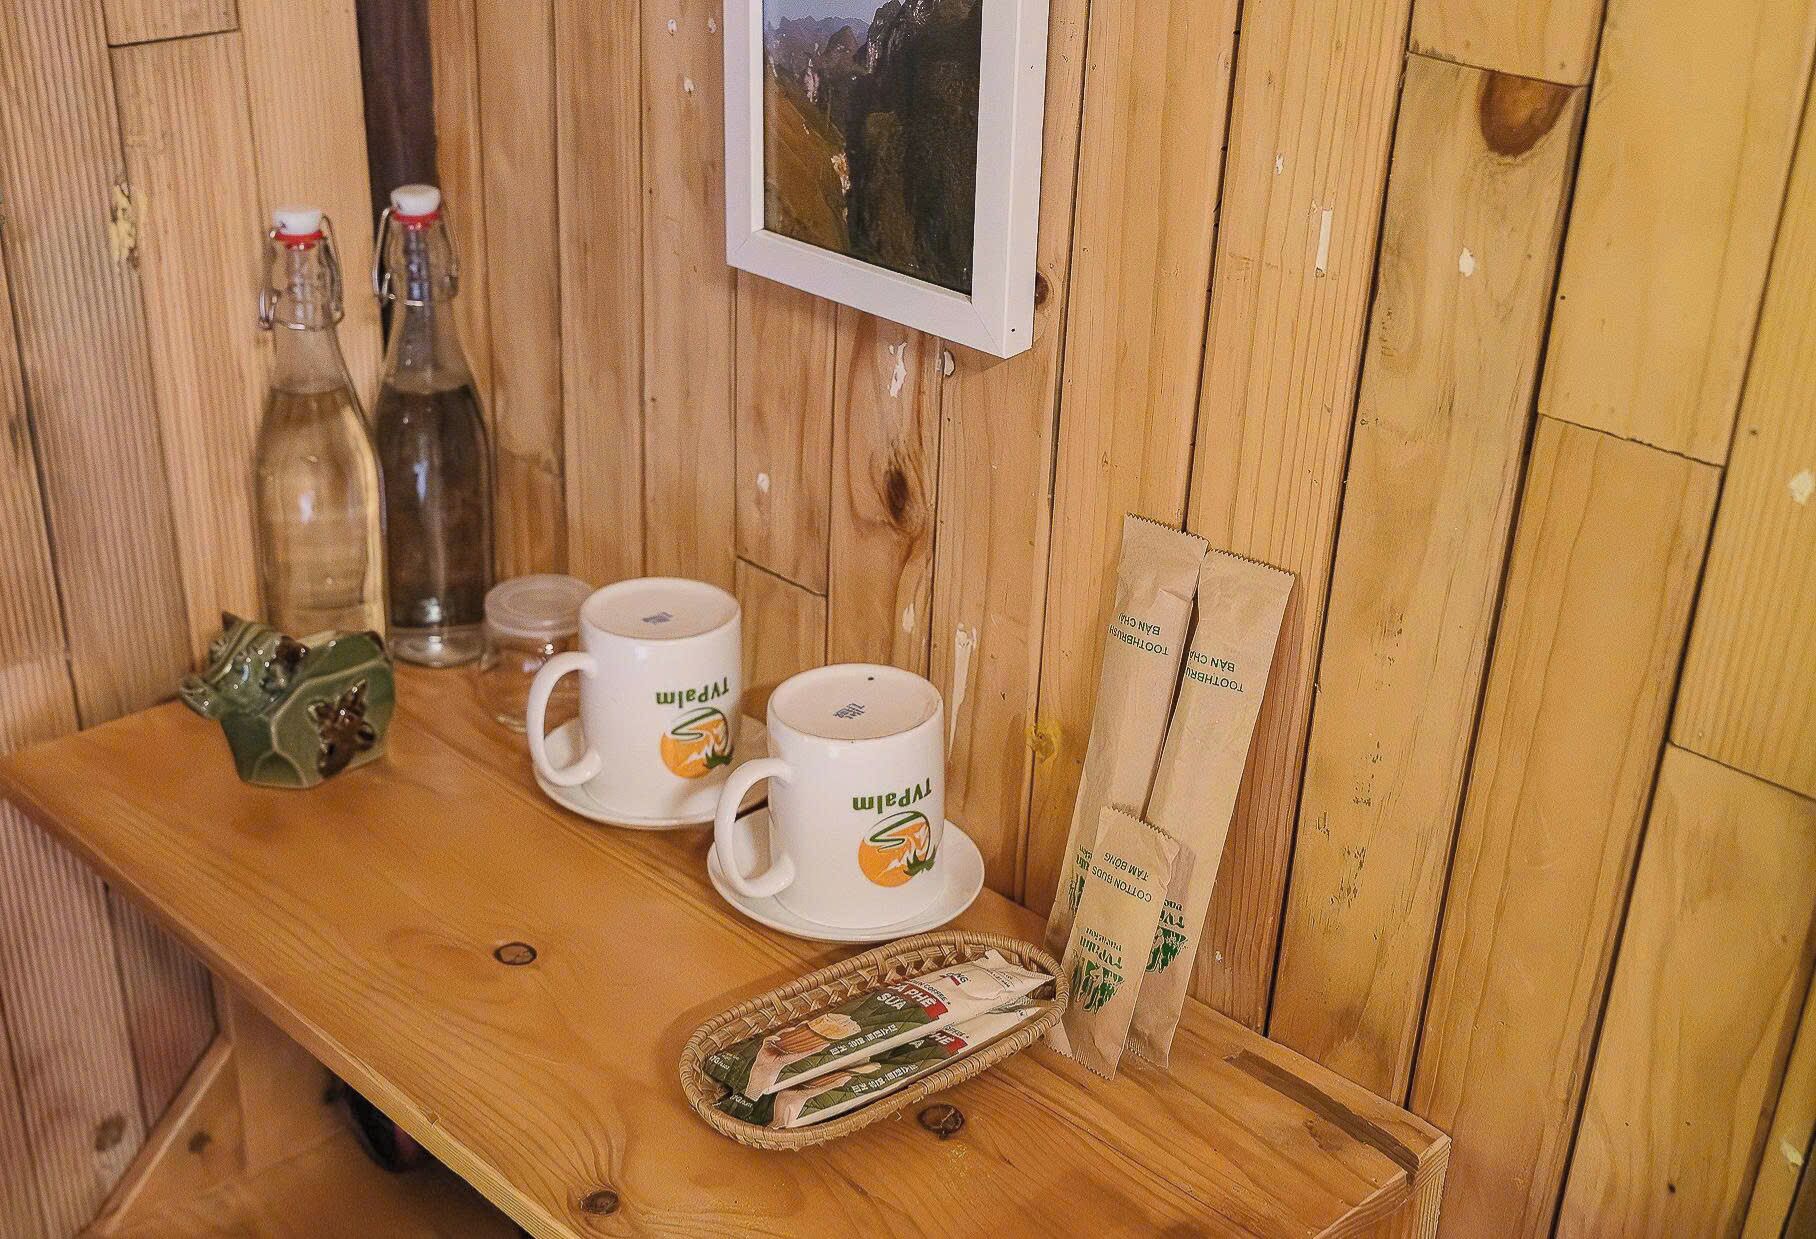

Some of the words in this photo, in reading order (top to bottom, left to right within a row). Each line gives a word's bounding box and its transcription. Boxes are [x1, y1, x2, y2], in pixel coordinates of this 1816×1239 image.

[1109, 624, 1169, 656] TOOTHBRUSH
[1138, 620, 1161, 636] BÀN
[1210, 657, 1235, 672] BÀN
[656, 676, 730, 708] TVPalm
[1185, 667, 1244, 692] TOOTHBRU
[852, 777, 932, 813] TVPalm
[1091, 865, 1113, 884] BUDS
[1114, 877, 1152, 903] COTTON
